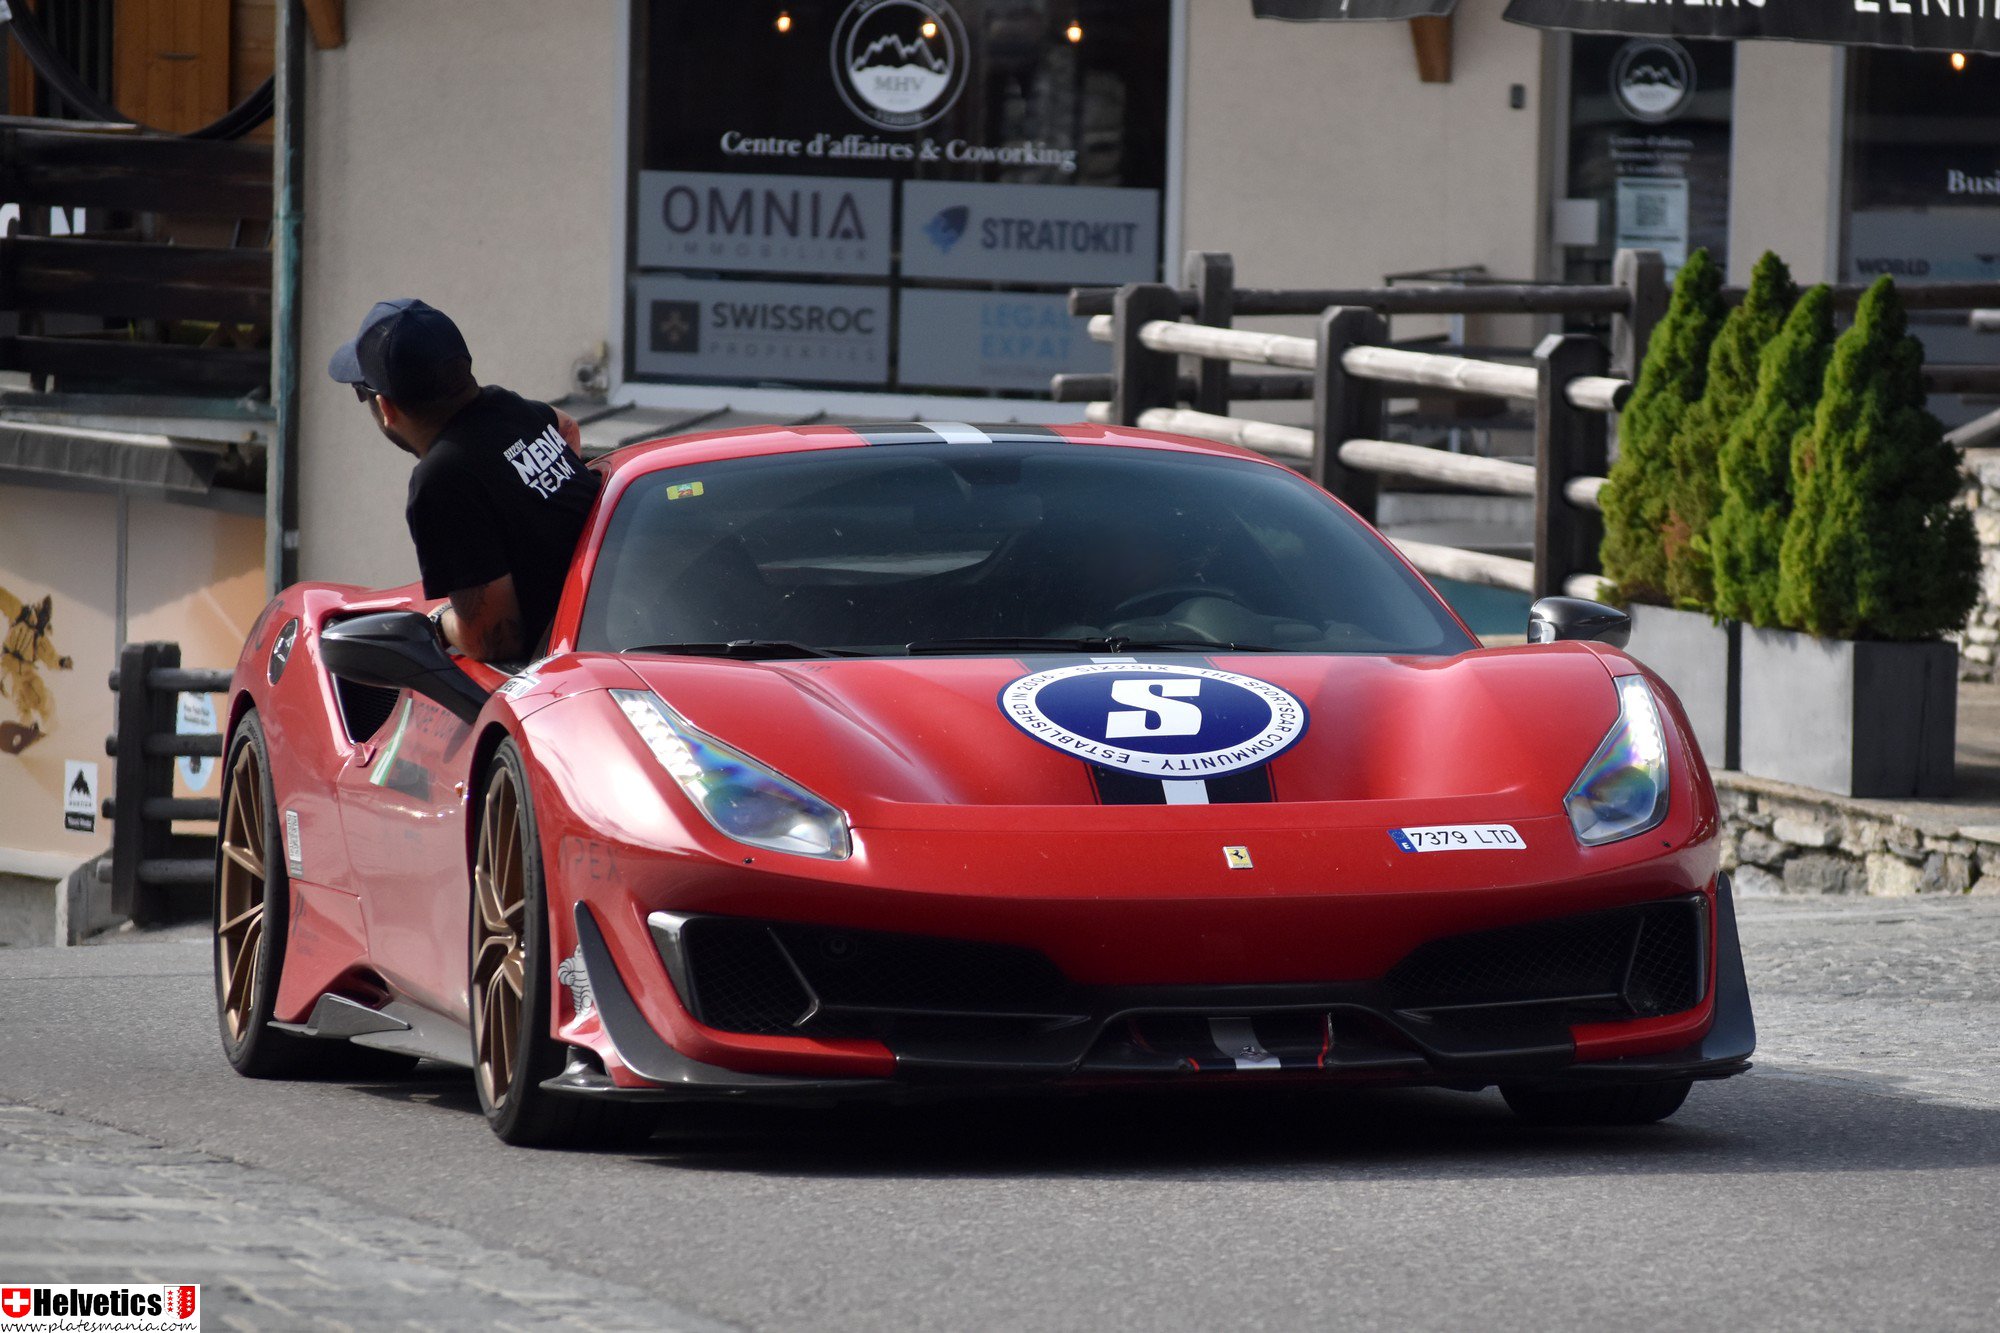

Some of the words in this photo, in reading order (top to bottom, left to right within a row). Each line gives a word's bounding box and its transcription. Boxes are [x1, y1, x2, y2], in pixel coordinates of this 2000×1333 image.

[720, 131, 802, 156] Centre
[806, 133, 914, 159] d'affaires
[920, 139, 941, 159] &
[945, 139, 1078, 173] Coworking
[662, 185, 866, 239] OMNIA
[981, 217, 1137, 253] STRATOKIT
[711, 302, 875, 334] SWISSROC
[511, 423, 567, 485] MEDIA
[528, 455, 576, 499] TEAM
[1011, 692, 1027, 701] IN
[1200, 670, 1242, 682] THE
[1105, 679, 1202, 738] S
[1243, 681, 1296, 733] SPORTSCAR
[1013, 703, 1131, 764] ESTABLISHED
[1160, 733, 1283, 771] COMMUNITY
[1410, 830, 1468, 846] 7379
[1474, 830, 1517, 844] LTD
